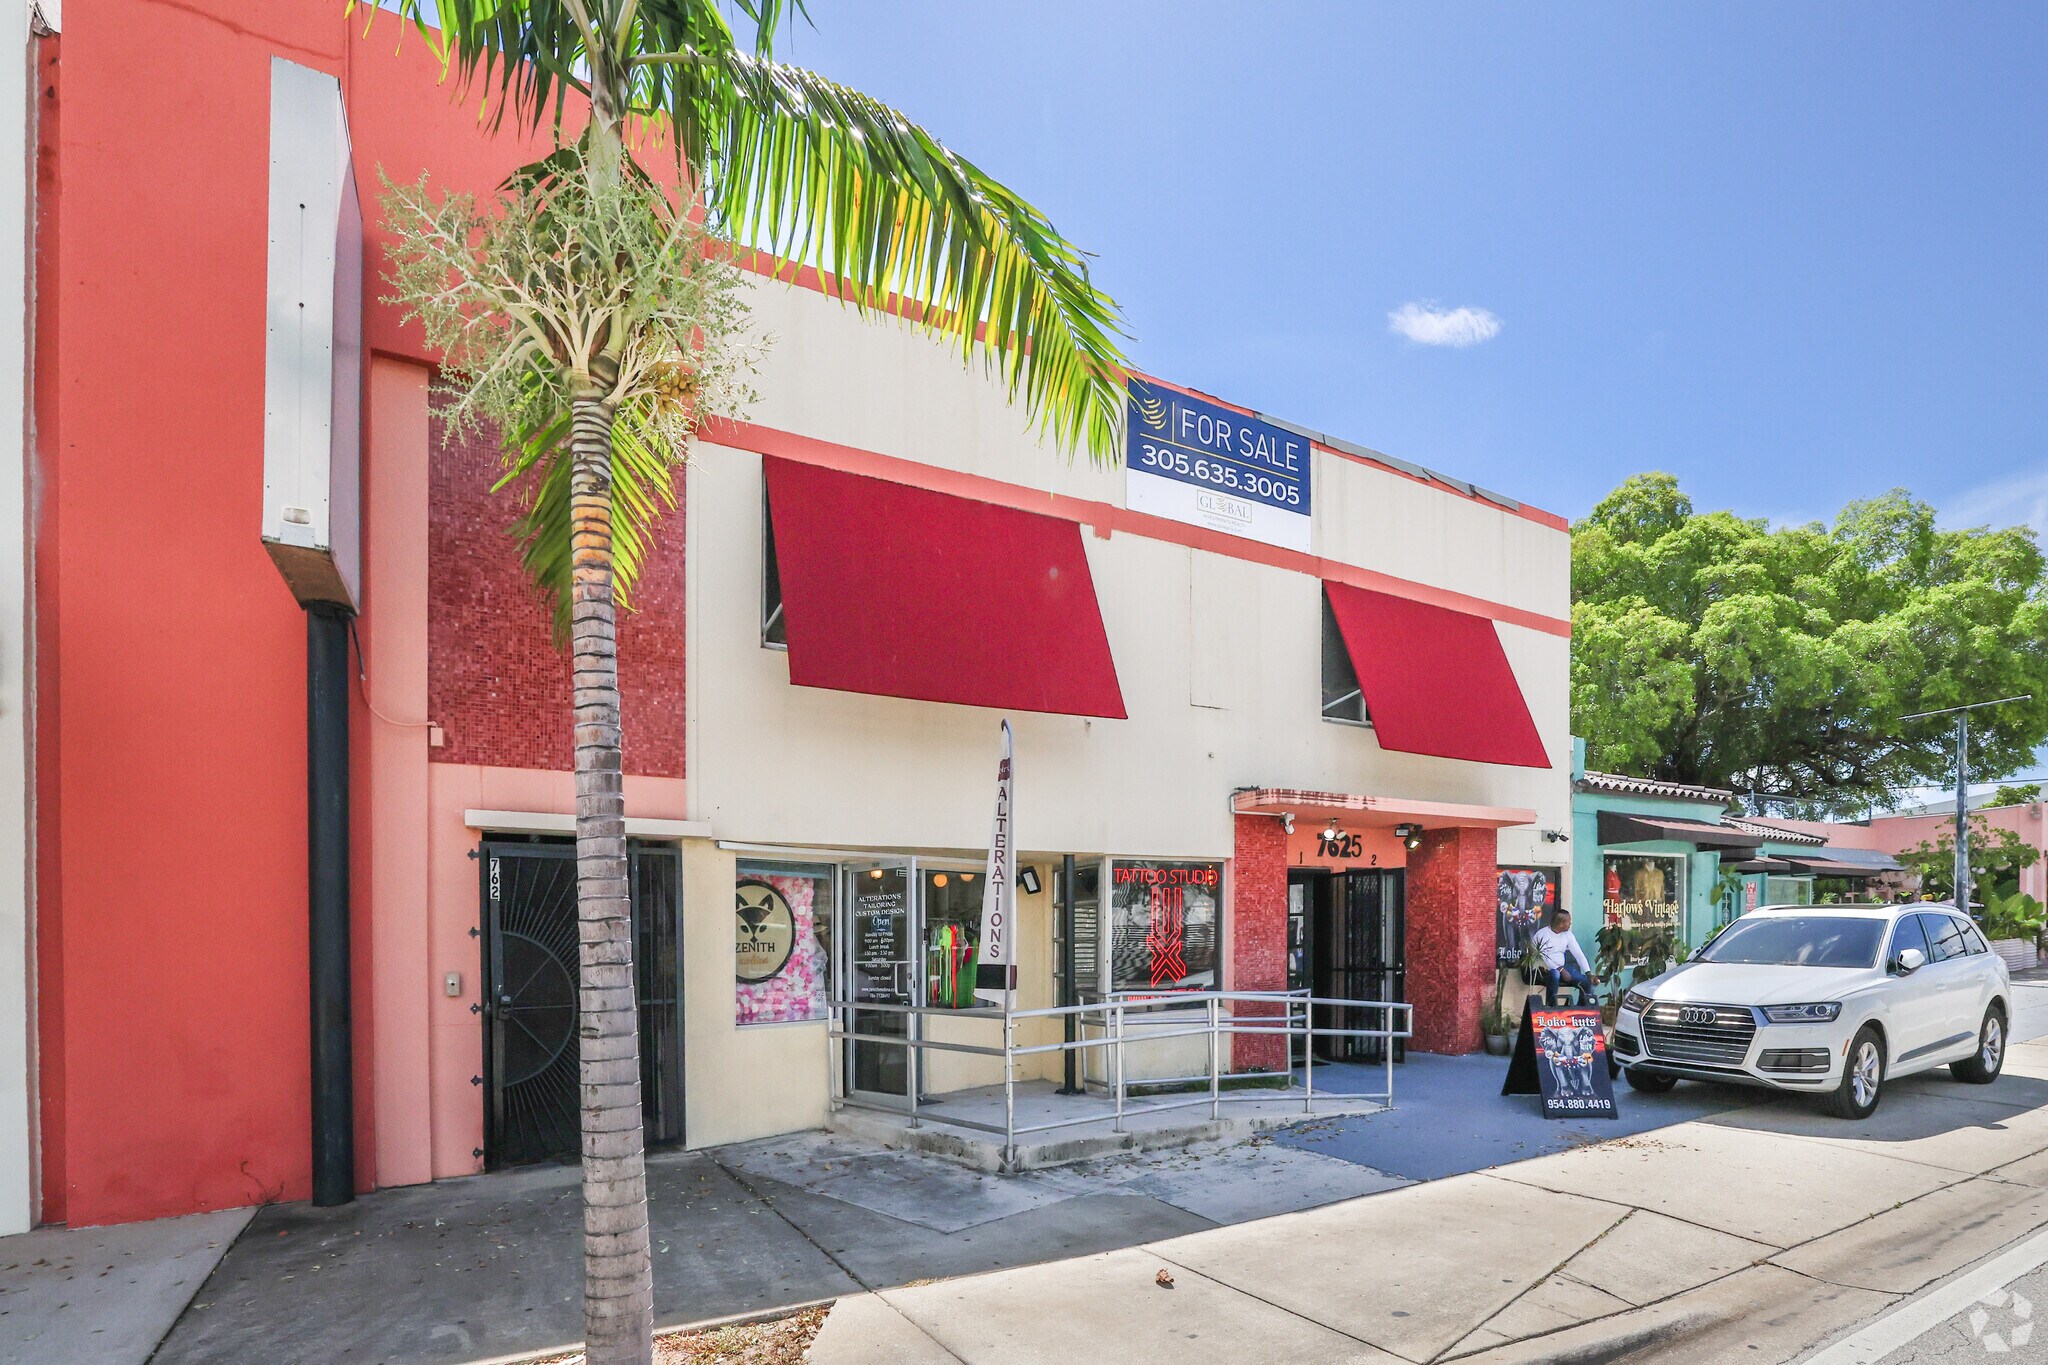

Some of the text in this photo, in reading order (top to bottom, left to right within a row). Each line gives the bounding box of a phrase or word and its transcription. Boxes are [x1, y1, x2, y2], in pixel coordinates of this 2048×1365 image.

[1182, 408, 1299, 472] FOR SALE
[1141, 444, 1300, 505] 305.635.3005
[1317, 829, 1363, 858] 7625
[1371, 854, 1377, 866] 2
[491, 859, 499, 898] 762
[990, 786, 1008, 958] ALTERATIONS
[1114, 868, 1219, 885] TATTOO STUDIO
[859, 893, 902, 902] ALTERATIONS
[864, 901, 896, 909] TAILORING
[1645, 899, 1679, 918] Vintage
[855, 909, 880, 917] CUSTOM
[872, 915, 890, 928] Open
[736, 942, 775, 953] ZENITH
[1537, 1016, 1597, 1027] Loko kuts
[1547, 1099, 1611, 1109] 954.880.4419
